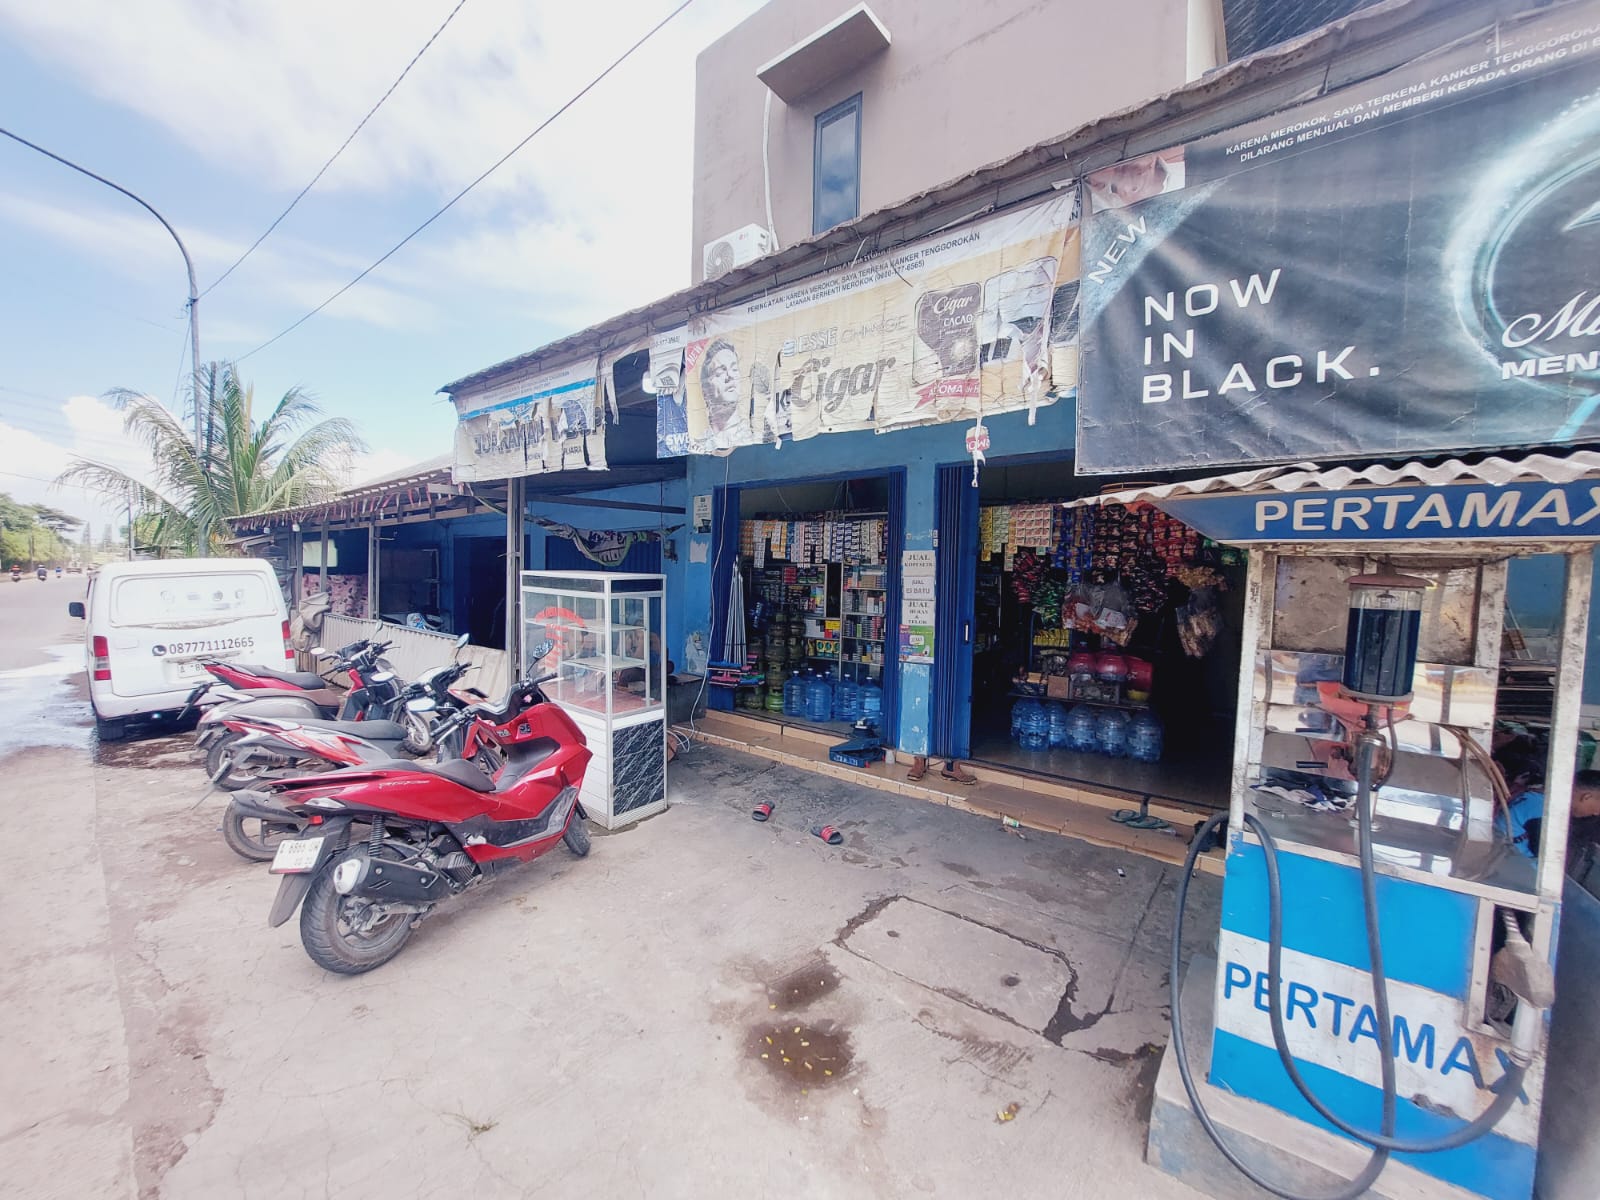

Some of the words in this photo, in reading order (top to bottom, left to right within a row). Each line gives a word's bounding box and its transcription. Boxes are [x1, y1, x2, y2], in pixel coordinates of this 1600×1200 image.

[1226, 134, 1269, 155] KARENA
[1270, 114, 1331, 139] MEROKOK,
[1333, 102, 1364, 120] SAYA
[1368, 82, 1428, 108] TERKENA
[1430, 60, 1489, 88] KANKER
[1240, 137, 1295, 163] DILARANG
[1297, 119, 1351, 144] MENJUAL
[1353, 109, 1380, 125] DAN
[1383, 88, 1445, 115] MEMBERI
[1447, 68, 1507, 94] KEPADA
[1509, 47, 1568, 74] ORANG
[1571, 41, 1588, 54] DI
[786, 288, 809, 302] KARENA
[841, 272, 858, 284] SAYA
[920, 231, 981, 257] TENGGOROKAN
[1087, 215, 1148, 286] NEW
[811, 287, 841, 301] BERHENTI
[841, 275, 874, 292] MEROKOK
[933, 295, 974, 316] Cigar
[1144, 267, 1281, 327] NOW
[943, 313, 974, 328] CACAO
[1143, 328, 1195, 366] IN
[687, 345, 704, 367] NEW
[790, 356, 897, 414] Cigar
[1141, 345, 1382, 404] BLACK.
